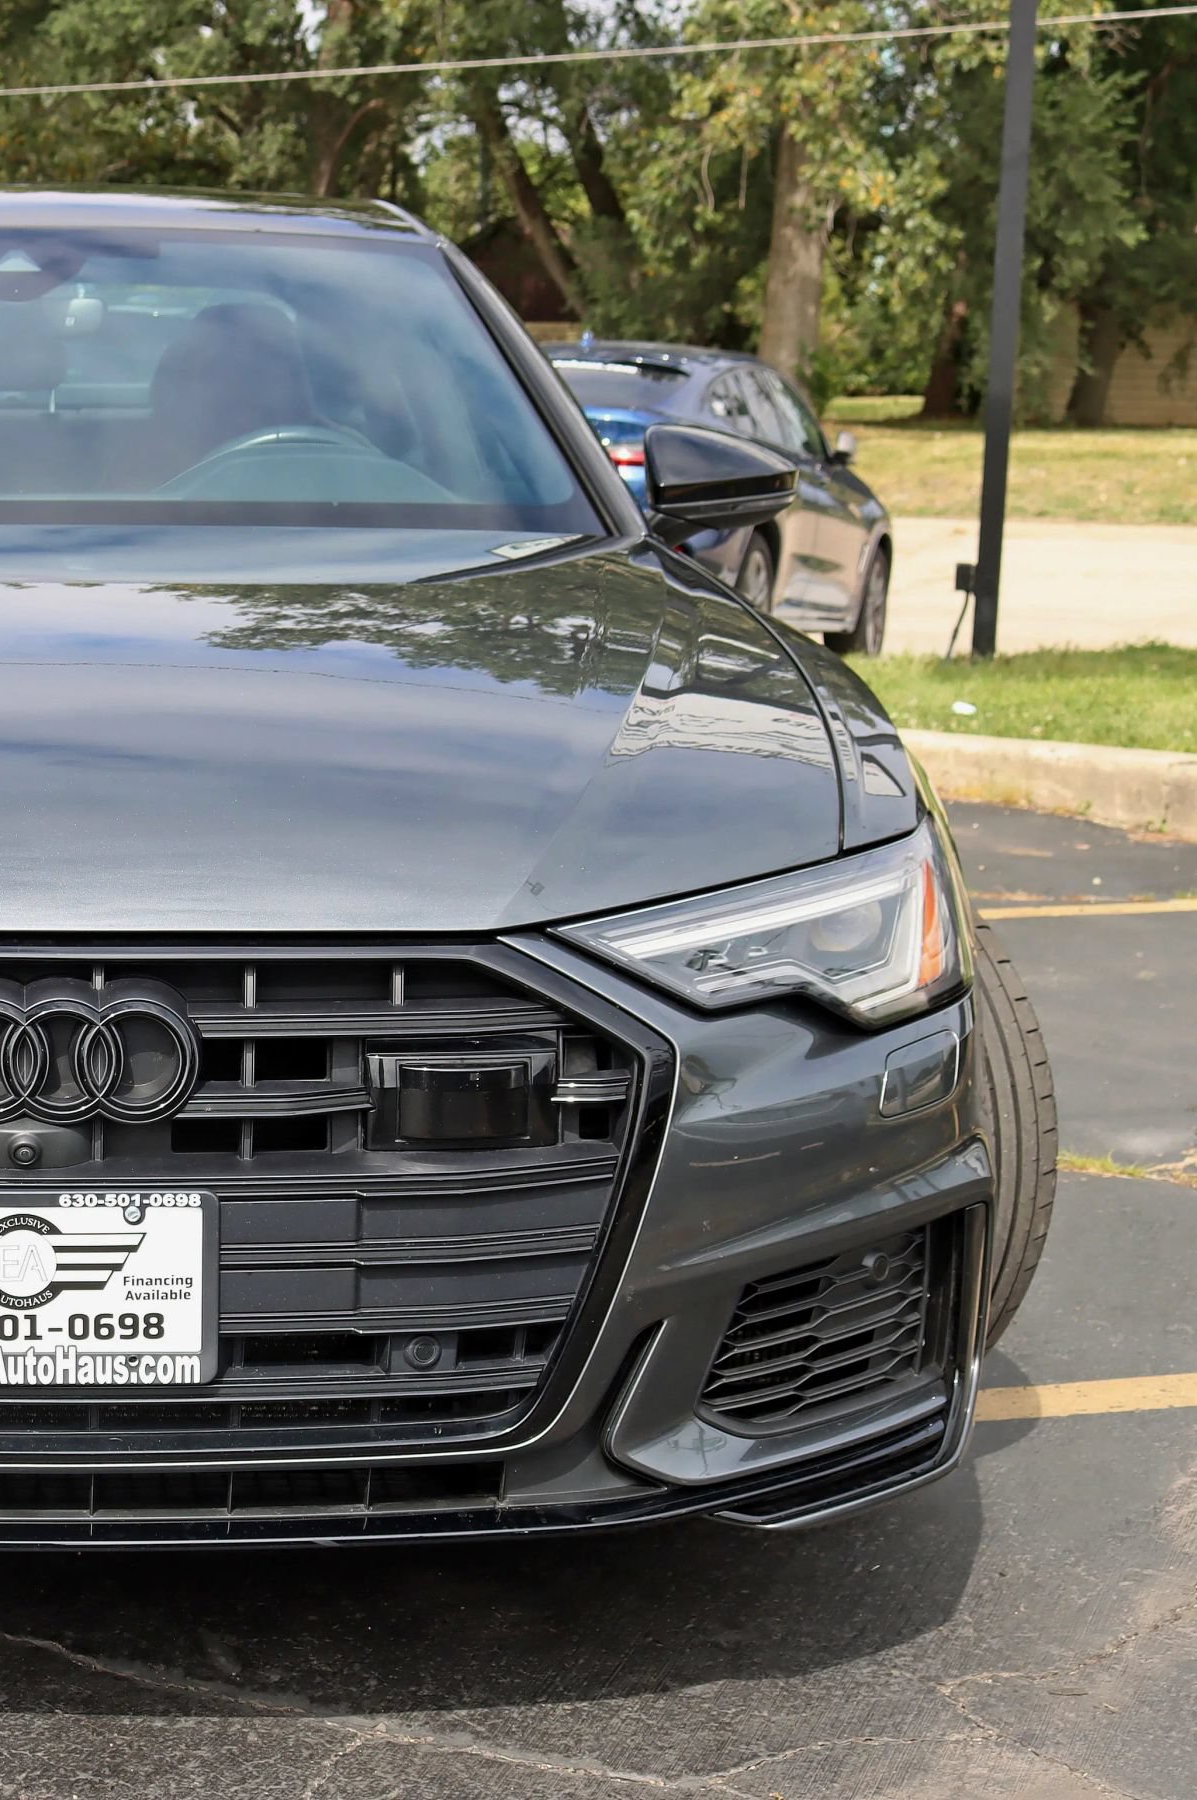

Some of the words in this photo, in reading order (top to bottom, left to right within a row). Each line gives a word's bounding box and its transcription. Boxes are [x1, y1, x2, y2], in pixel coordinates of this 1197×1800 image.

[58, 1193, 202, 1208] 630-501-0698
[123, 1274, 193, 1289] Financing
[125, 1289, 192, 1301] Available
